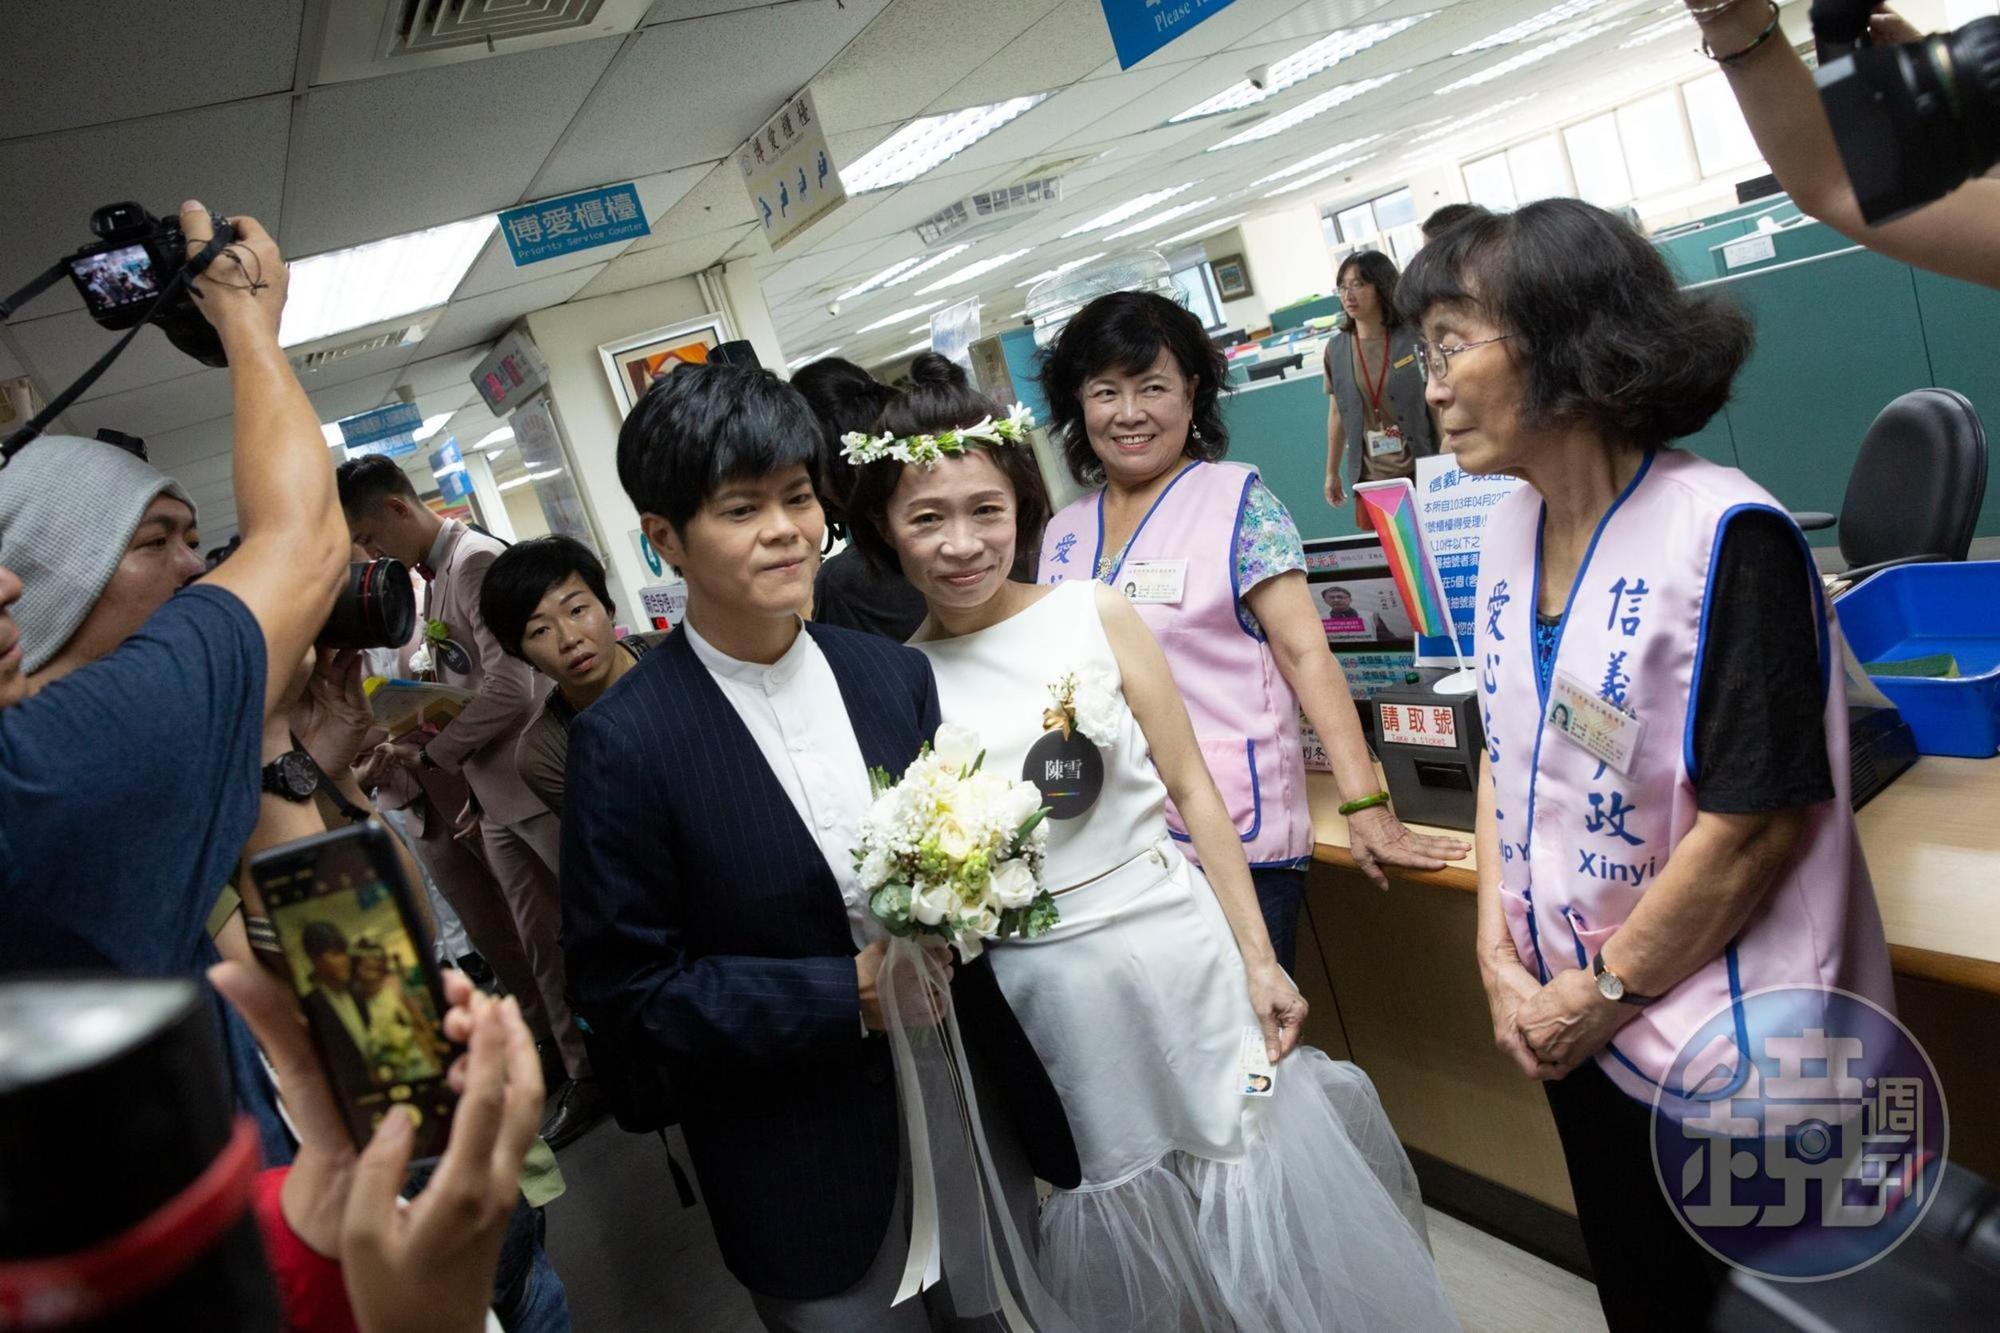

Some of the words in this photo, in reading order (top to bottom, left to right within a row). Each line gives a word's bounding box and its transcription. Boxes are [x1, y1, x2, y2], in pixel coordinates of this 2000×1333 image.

[1154, 2, 1191, 32] Please
[508, 193, 639, 247] 博愛櫃檯
[518, 241, 562, 259] Priority
[567, 231, 605, 246] Service
[608, 222, 643, 236] Counter
[1382, 706, 1453, 735] 請取號
[1585, 577, 1650, 846] 信義政
[1045, 759, 1082, 781] 陳雪
[1578, 849, 1656, 887] Xinyi
